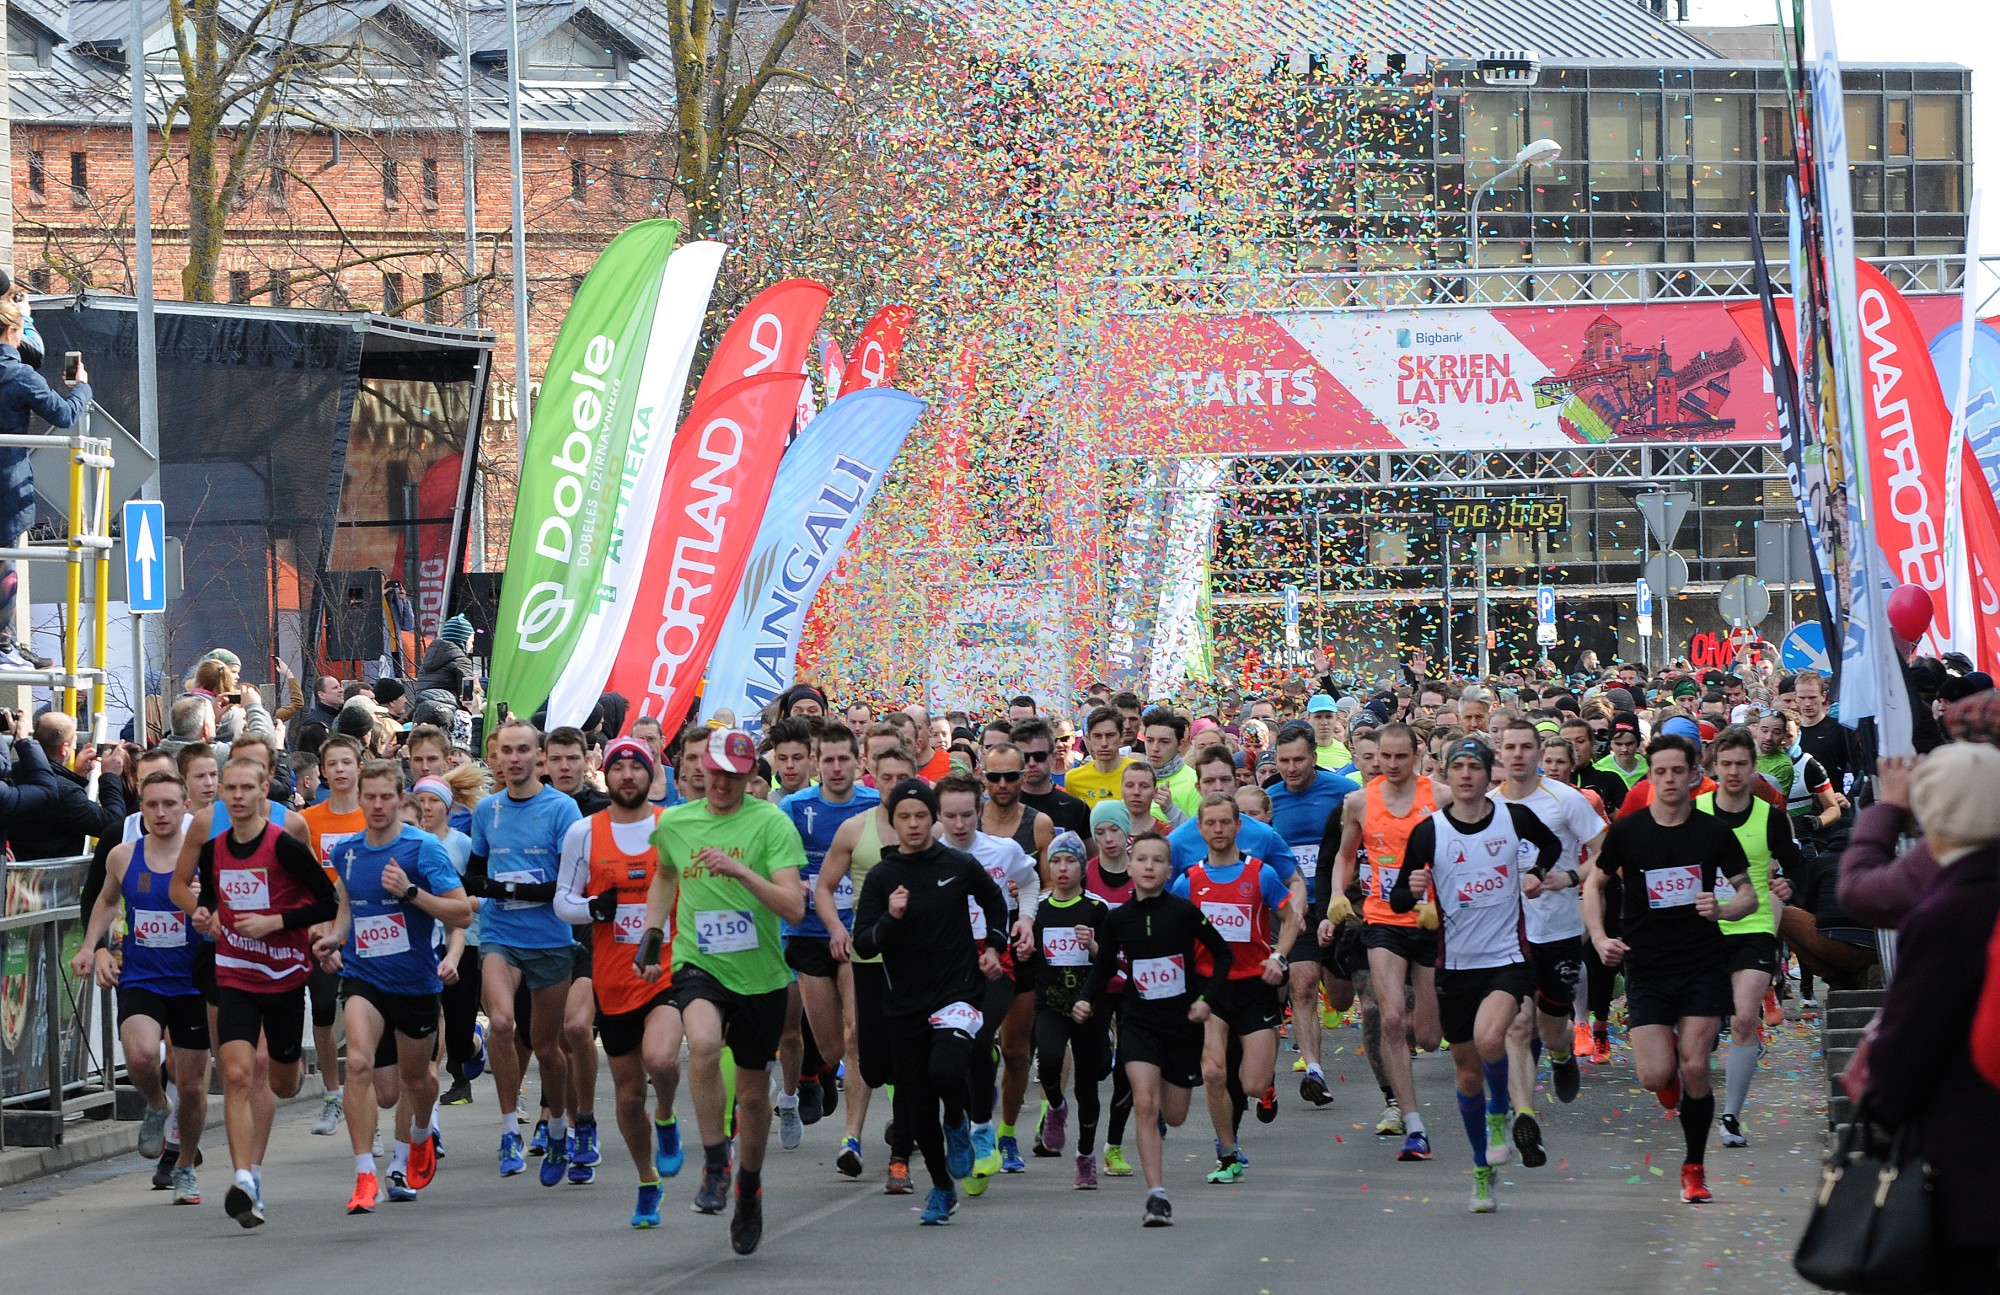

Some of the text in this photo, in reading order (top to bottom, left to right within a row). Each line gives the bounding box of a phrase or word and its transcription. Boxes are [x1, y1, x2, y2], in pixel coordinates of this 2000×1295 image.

[1416, 332, 1463, 346] Bigbank
[1397, 353, 1510, 380] SKRIEN
[1397, 378, 1523, 405] LATVIJA
[535, 334, 616, 564] Dobele
[577, 498, 598, 567] DOBELES
[1287, 589, 1296, 620] P
[1640, 583, 1649, 610] P
[1542, 592, 1552, 618] P
[1296, 854, 1317, 866] 254
[225, 882, 260, 895] 4537
[1464, 876, 1504, 894] 4603
[1655, 877, 1695, 893] 4587
[141, 921, 180, 934] 4014
[621, 915, 643, 929] 46
[703, 920, 748, 937] 2150
[1208, 914, 1244, 928] 4640
[361, 925, 400, 941] 4038
[1140, 968, 1178, 984] 4161
